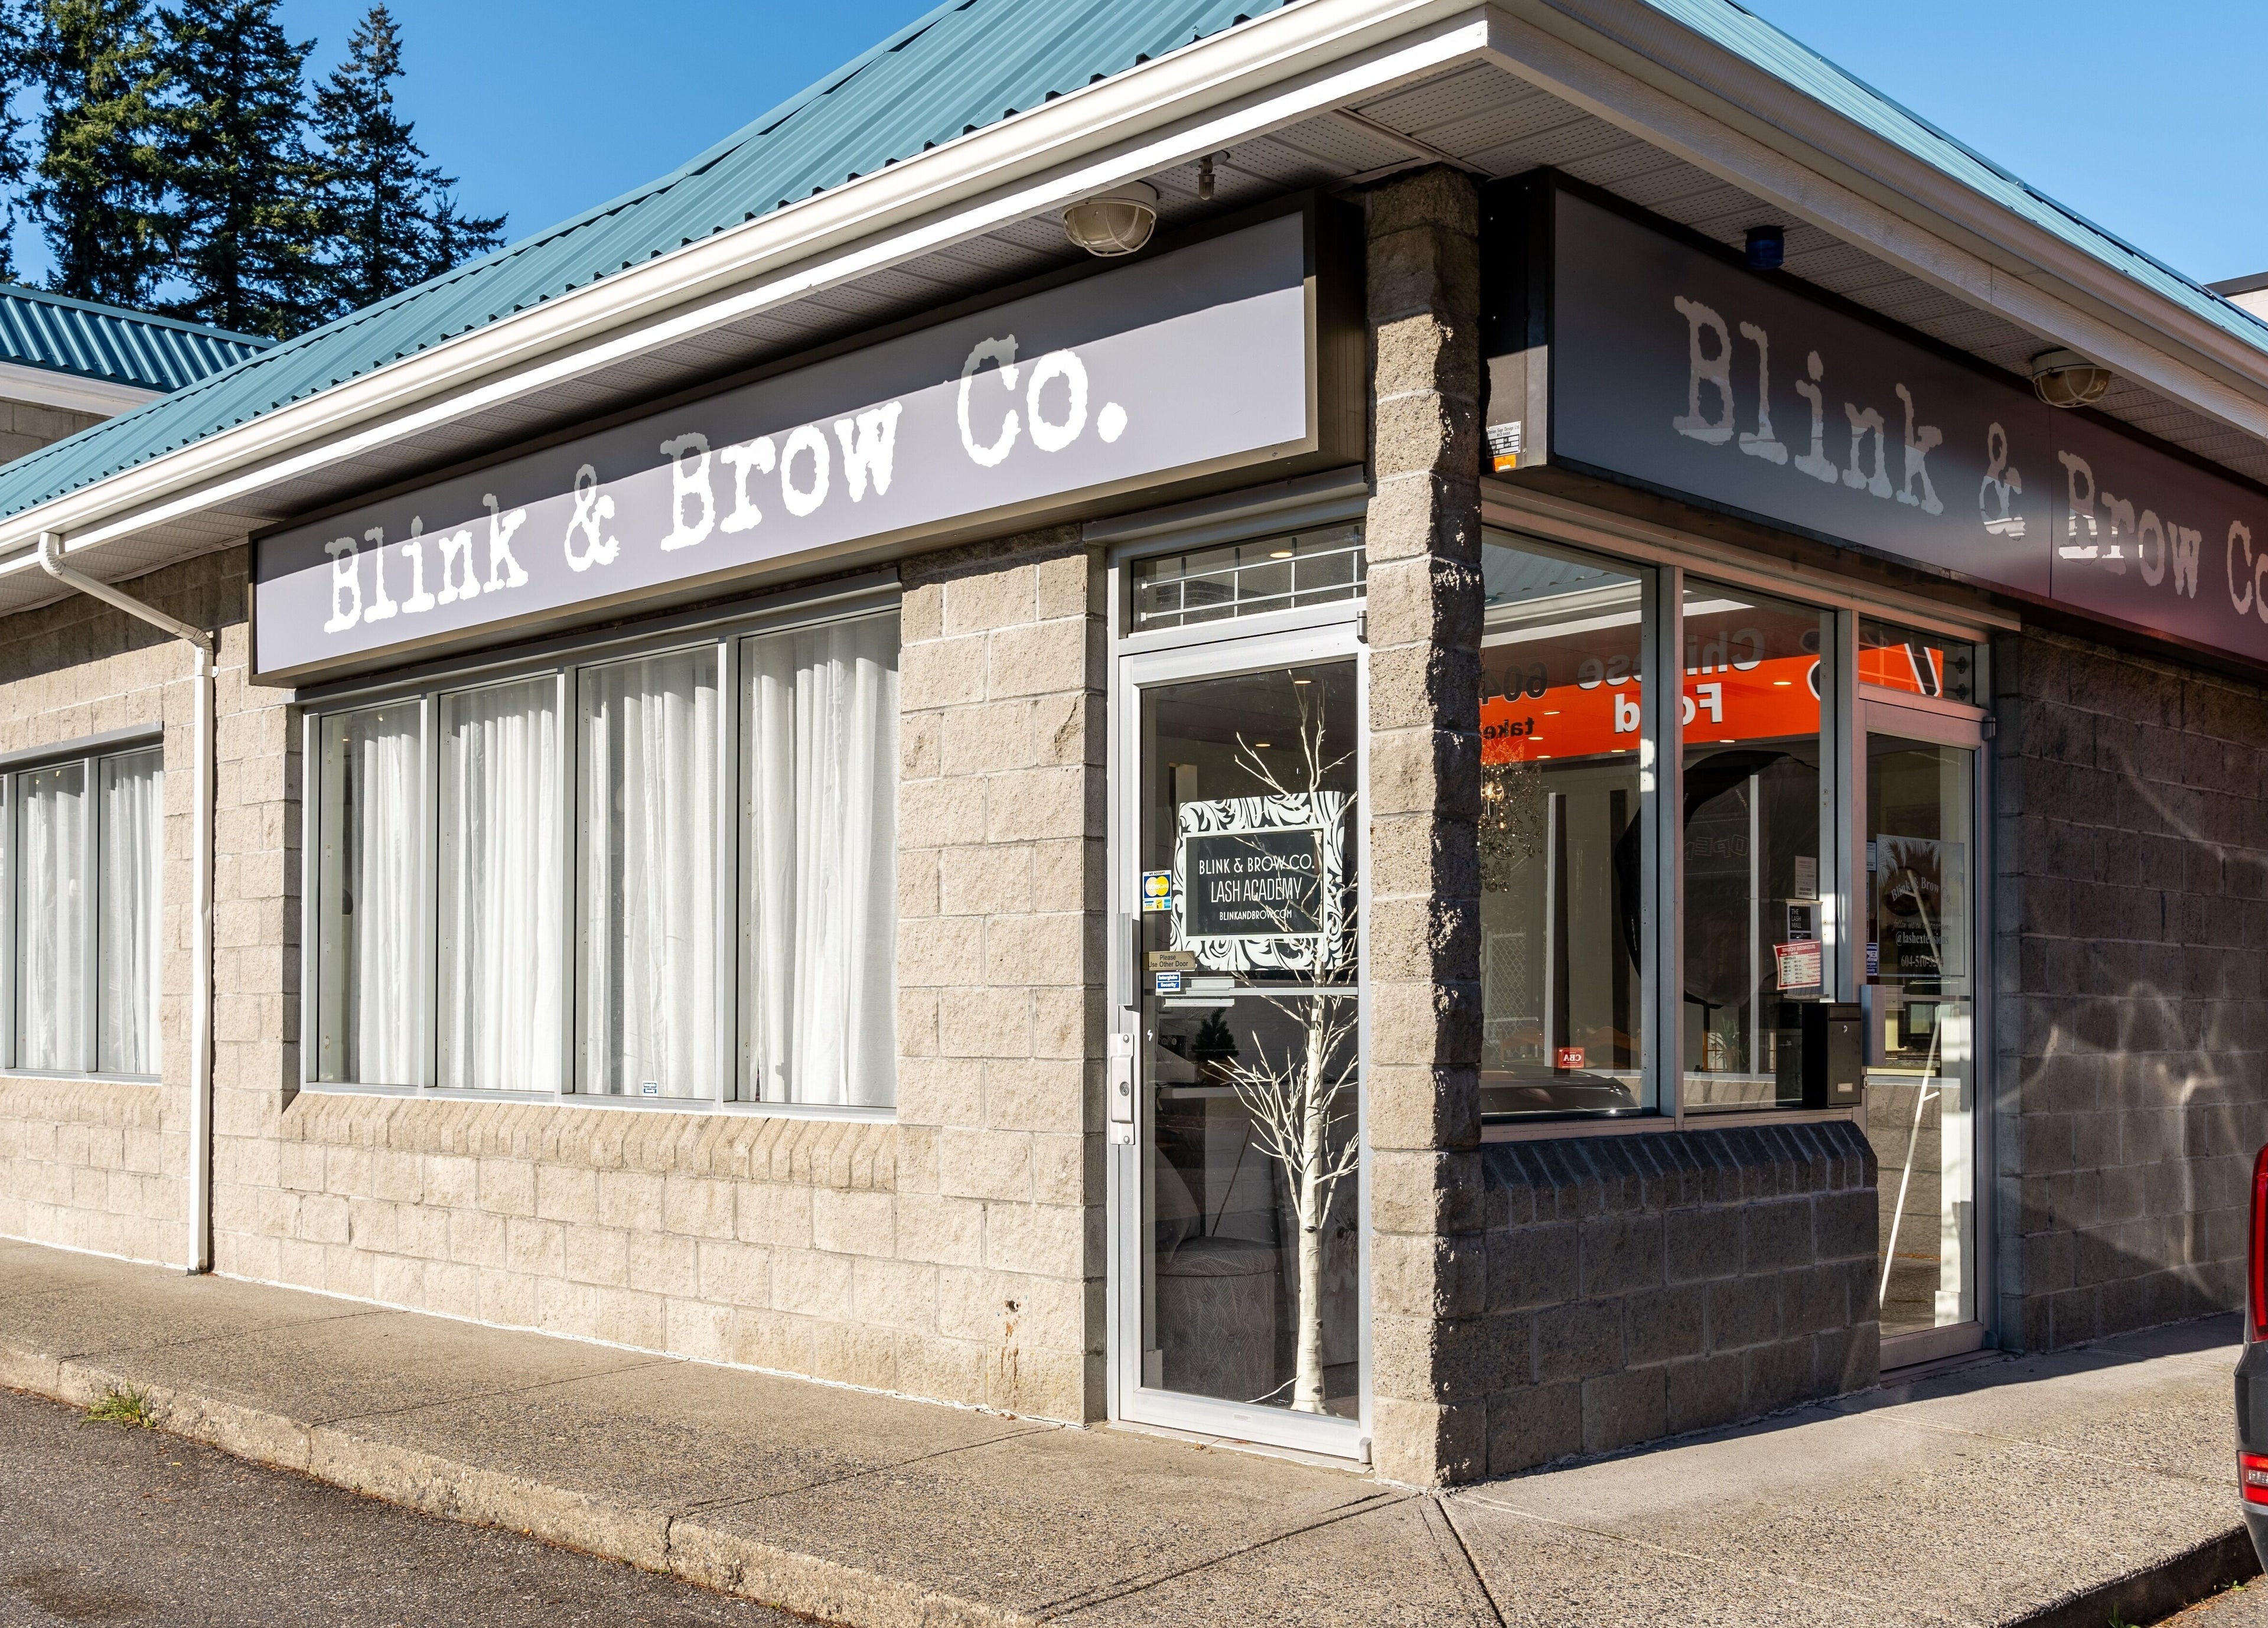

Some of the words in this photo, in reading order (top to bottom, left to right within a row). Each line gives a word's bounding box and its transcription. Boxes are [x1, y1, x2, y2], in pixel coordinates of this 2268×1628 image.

[1672, 295, 1944, 516] Blink
[1978, 421, 2028, 542] &
[2058, 449, 2203, 600] Brow
[323, 492, 529, 635] Blink
[563, 463, 621, 572] &
[659, 399, 904, 552] Brow
[956, 333, 1129, 468] Co.
[1199, 858, 1230, 875] BLINK
[1233, 858, 1243, 873] &
[1247, 855, 1286, 872] BROW
[1289, 854, 1315, 870] CO.
[1211, 881, 1240, 903] LASH
[1243, 877, 1302, 901] ACADEMY
[1921, 877, 1940, 894] Brow
[1219, 909, 1292, 921] BLINKANDBROWCOM
